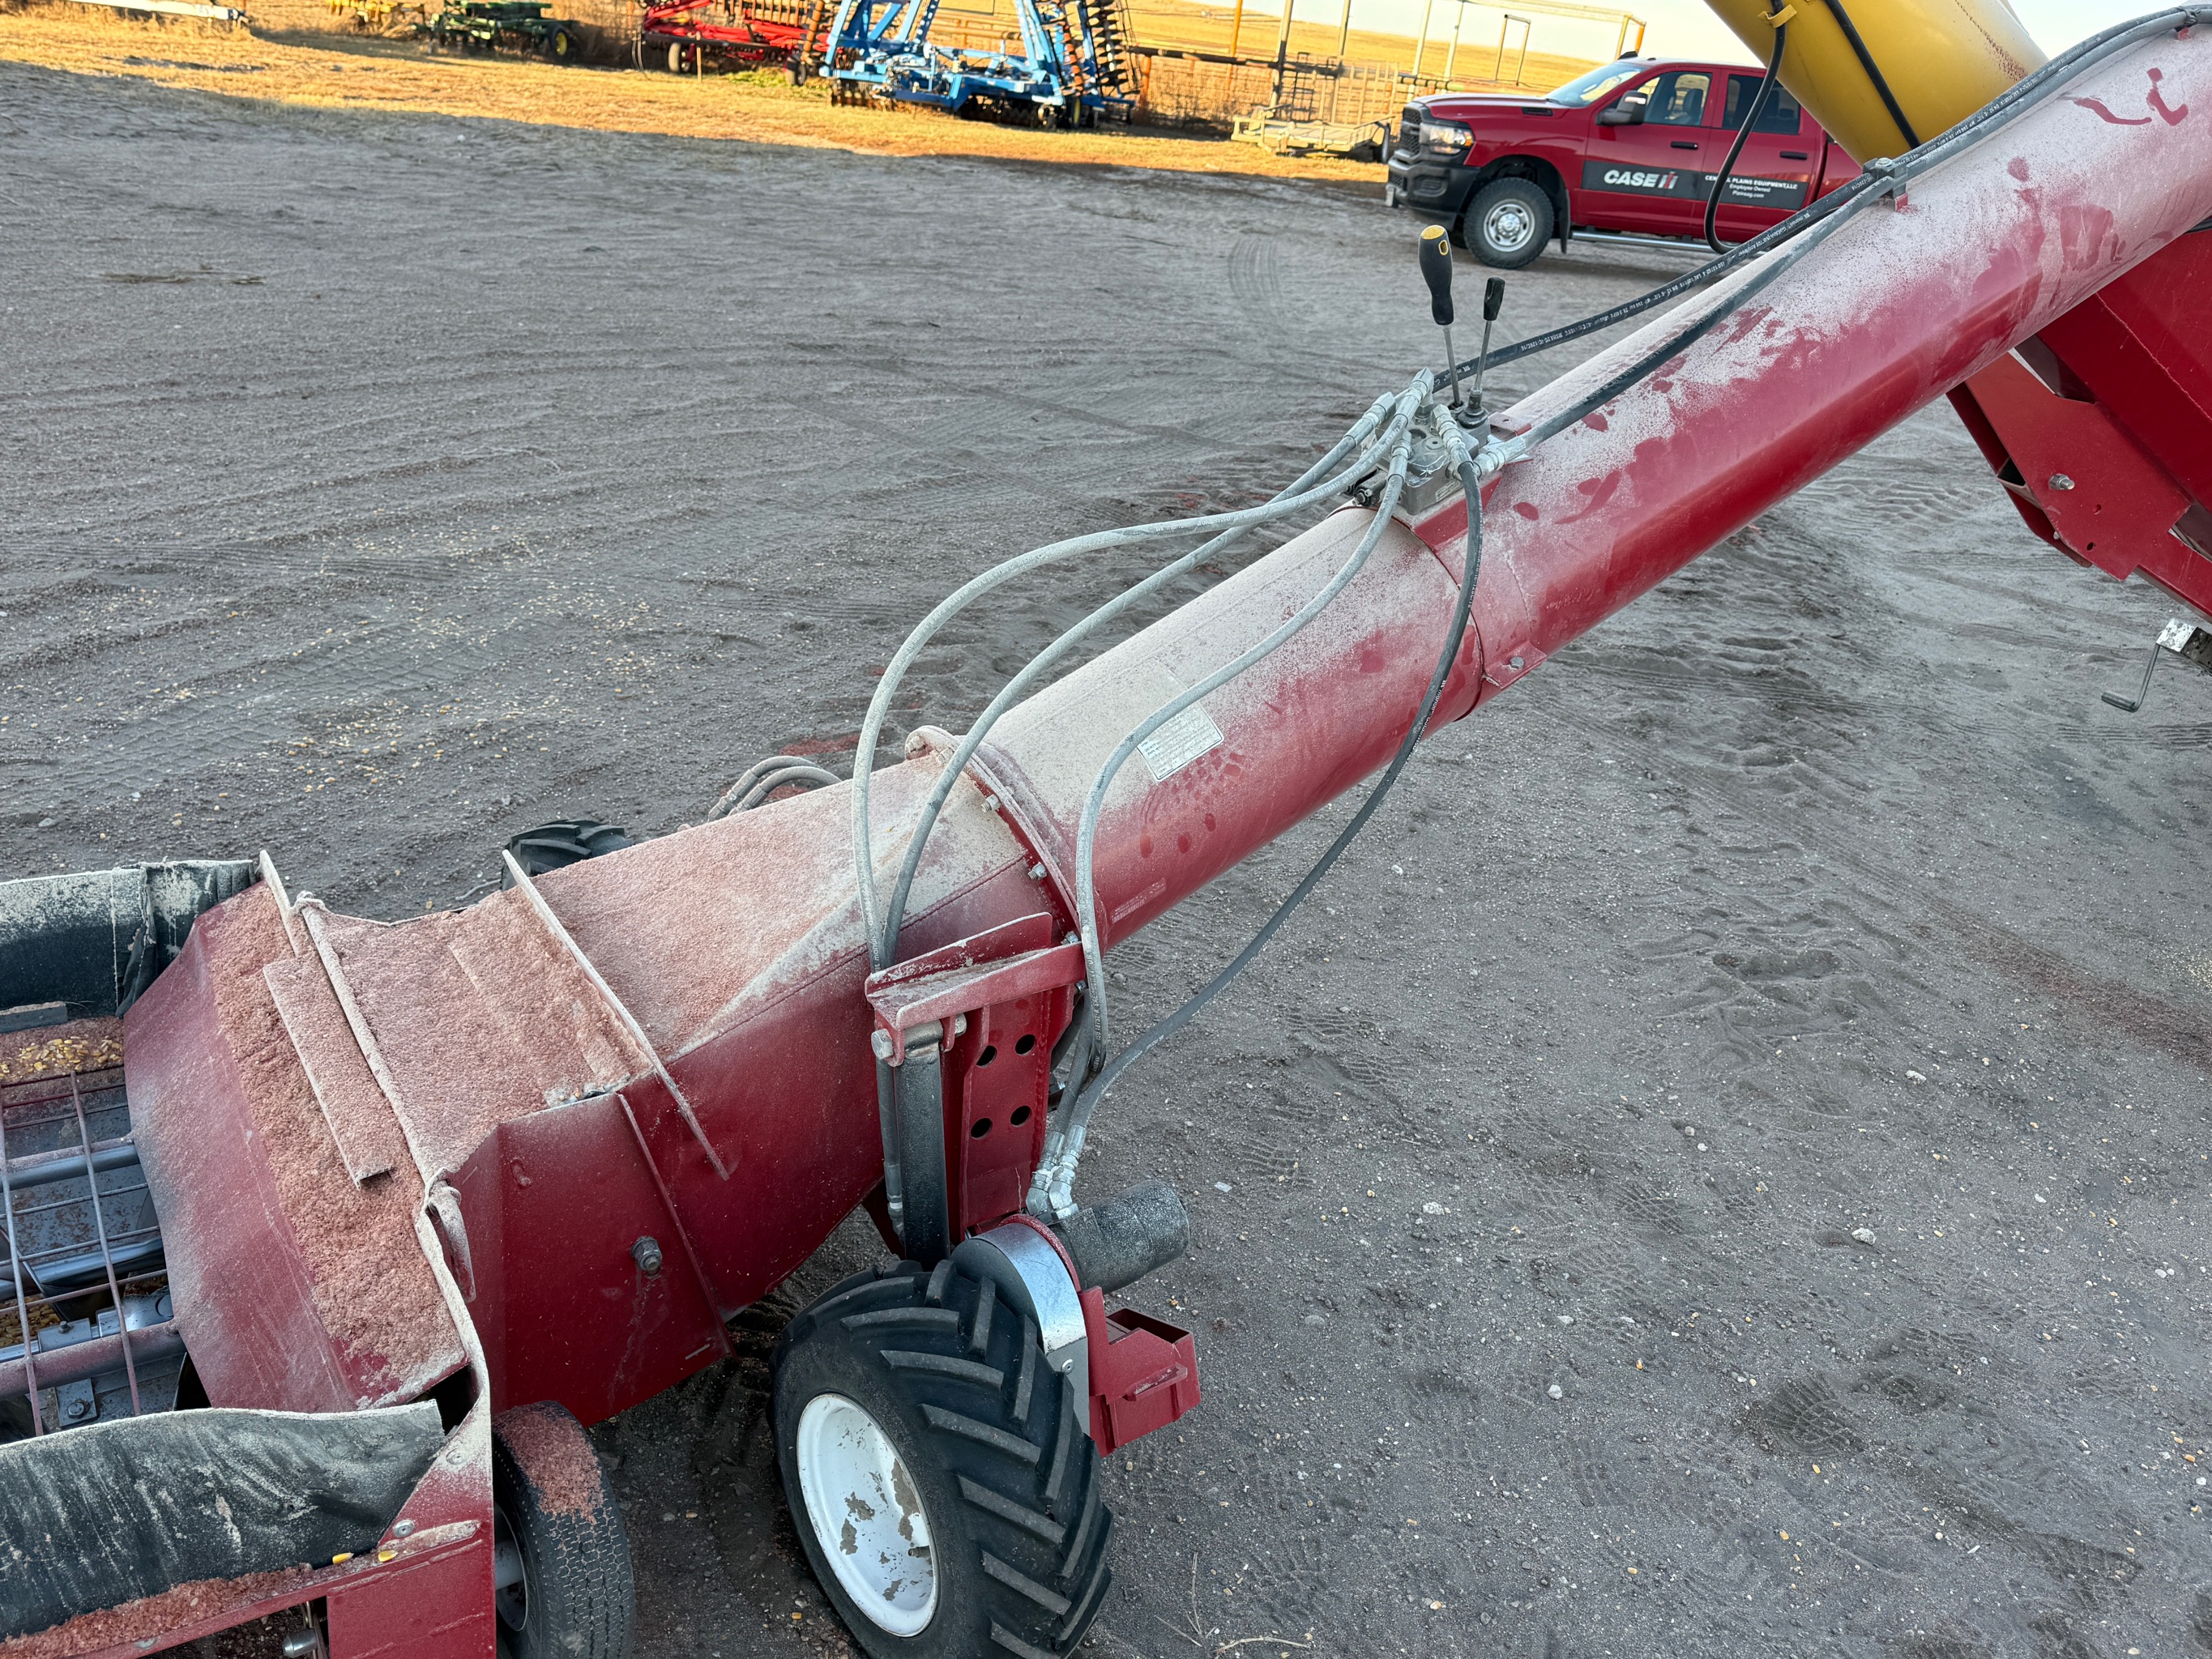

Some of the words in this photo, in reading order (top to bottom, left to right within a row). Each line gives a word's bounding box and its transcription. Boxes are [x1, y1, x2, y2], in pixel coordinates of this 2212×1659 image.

[1603, 169, 1659, 187] CASE
[1729, 183, 1753, 191] Employee
[869, 936, 879, 961] manuli
